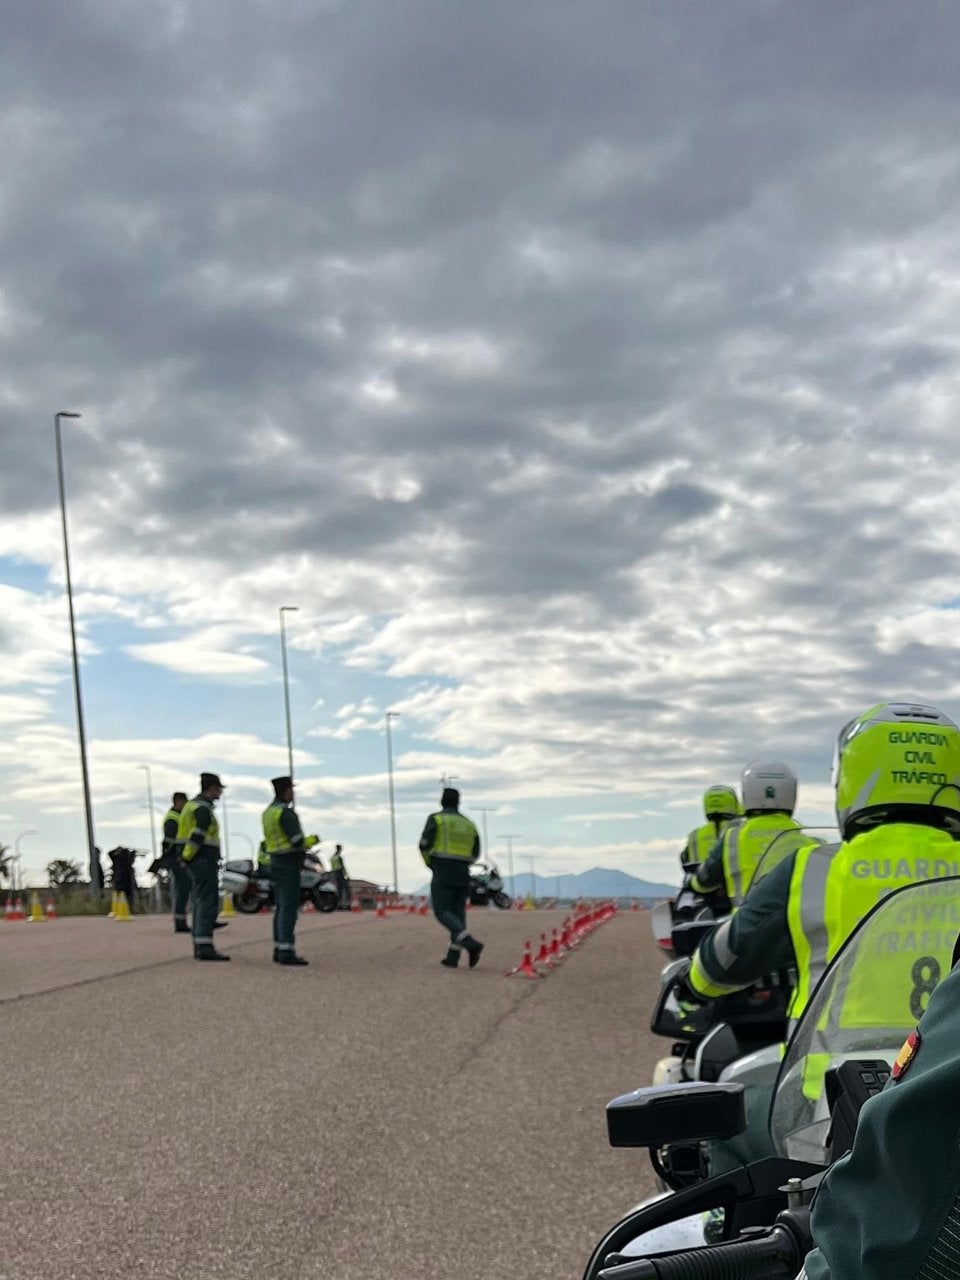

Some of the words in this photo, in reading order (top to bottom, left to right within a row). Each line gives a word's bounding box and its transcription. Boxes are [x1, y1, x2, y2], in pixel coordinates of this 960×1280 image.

[889, 731, 949, 748] GUARDIA
[904, 750, 936, 765] CIVIL
[891, 769, 948, 786] TRÁFICO
[896, 903, 960, 925] CIVIL
[876, 930, 958, 954] TRAFIC
[910, 956, 941, 1021] 8
